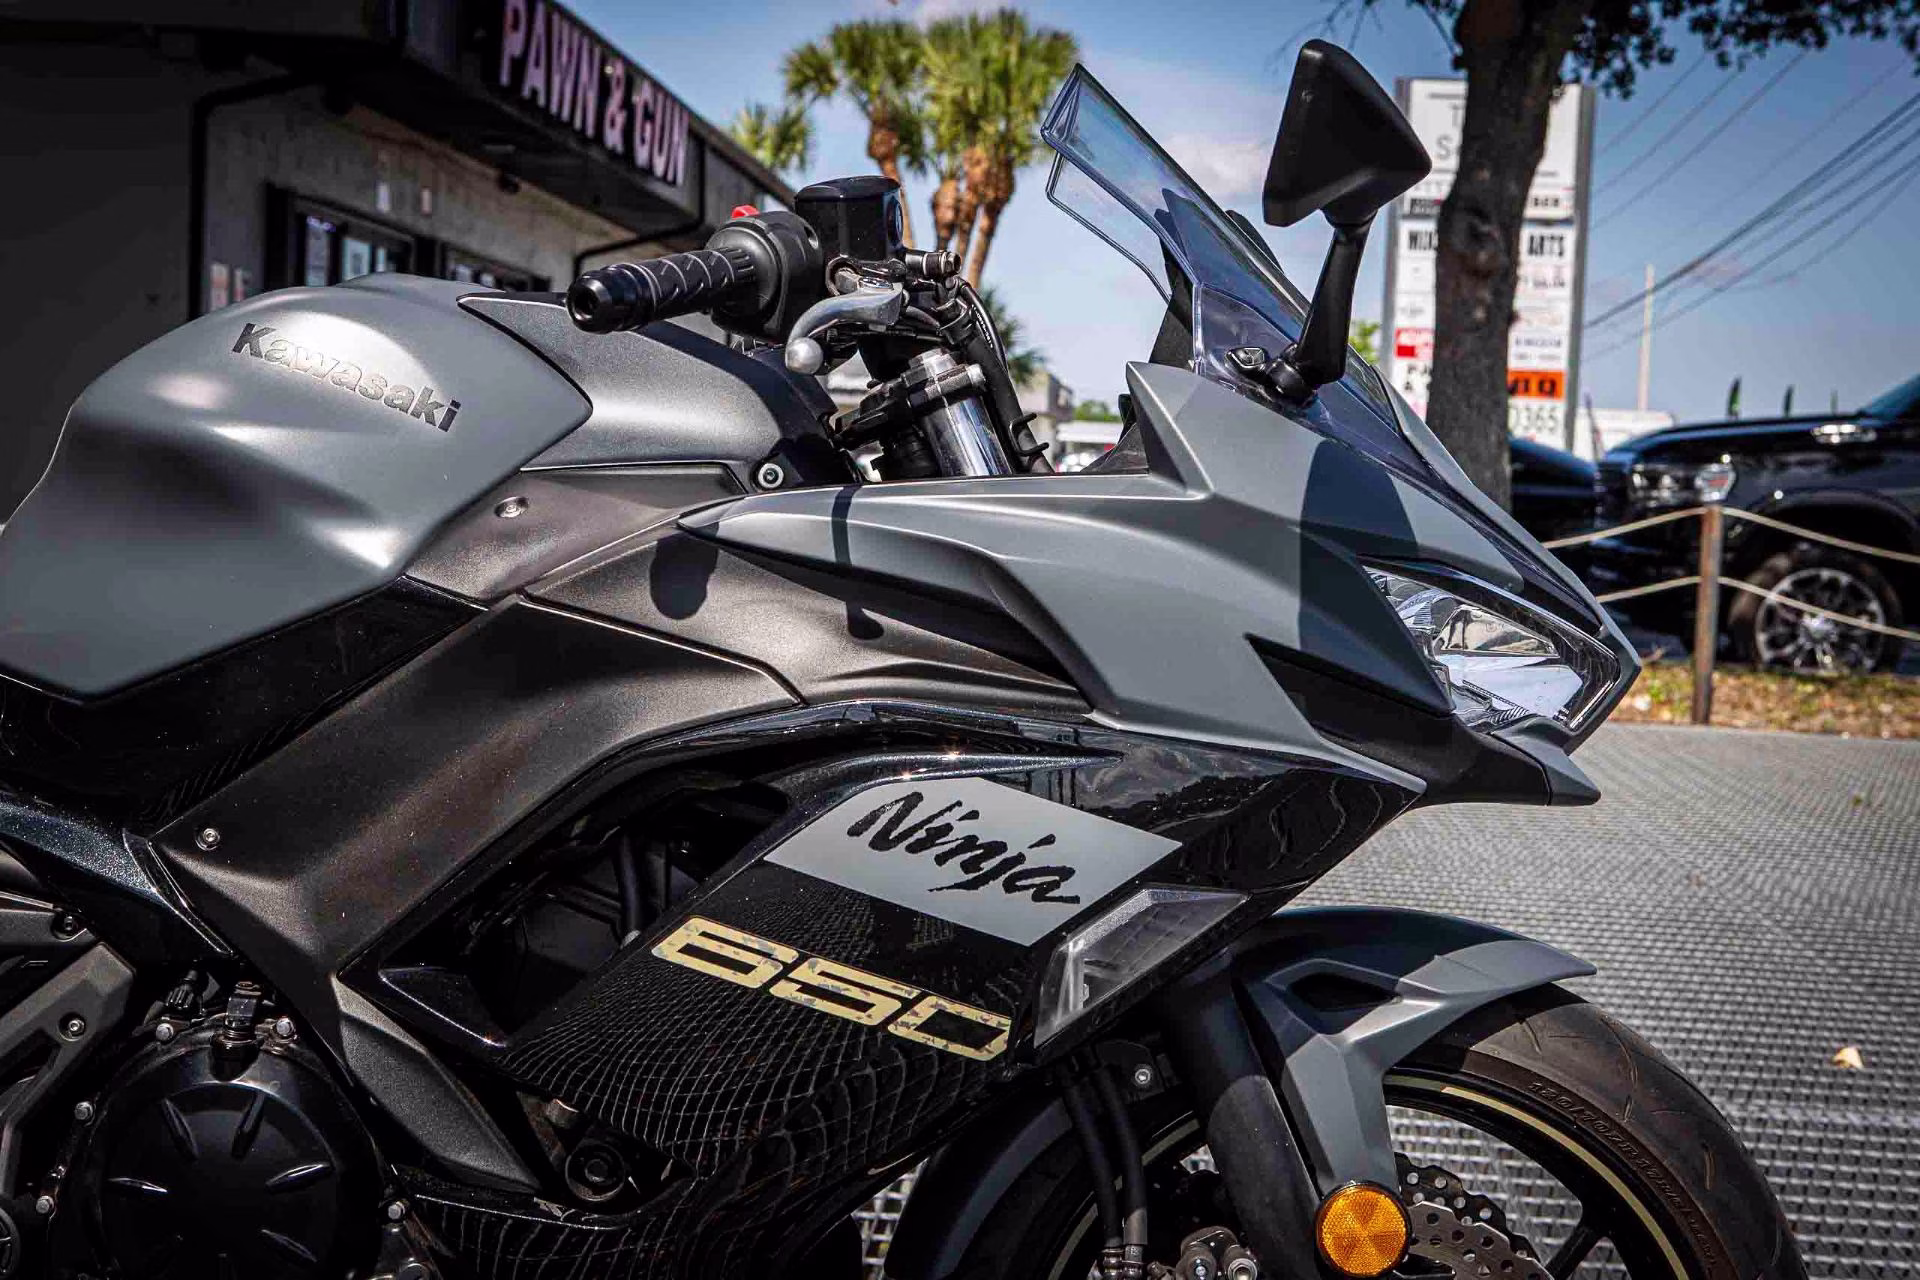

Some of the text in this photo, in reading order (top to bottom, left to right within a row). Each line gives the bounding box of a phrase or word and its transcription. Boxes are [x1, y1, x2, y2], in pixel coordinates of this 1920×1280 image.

[500, 0, 690, 187] PAWN & GUN
[232, 322, 461, 432] Kawasaki
[846, 790, 1082, 905] Ninja
[651, 915, 1015, 1062] 650
